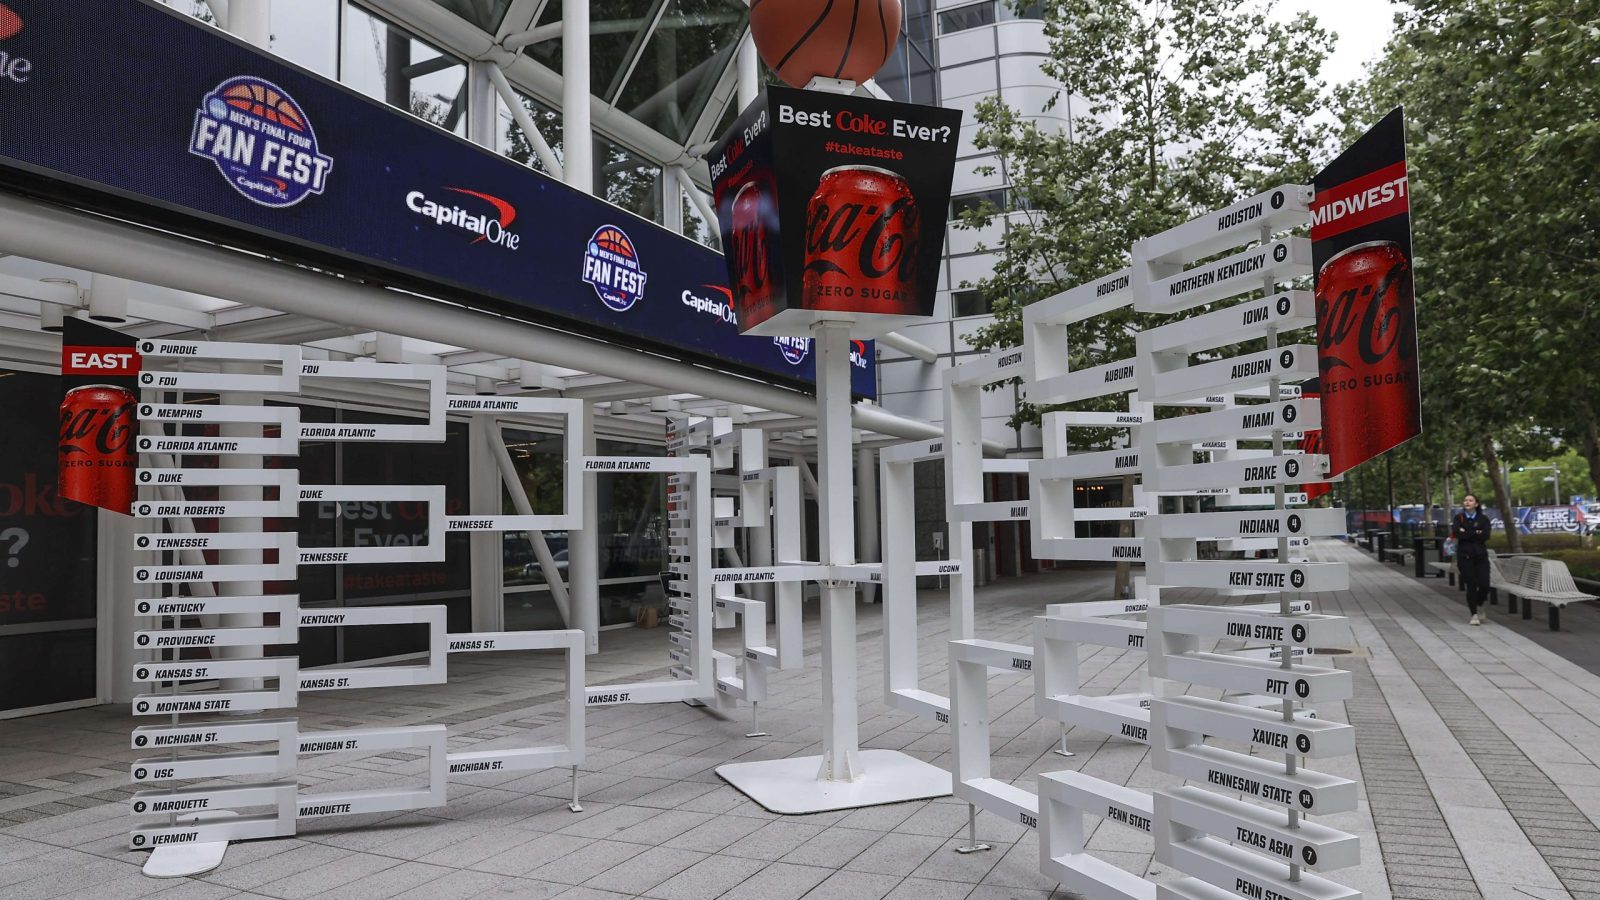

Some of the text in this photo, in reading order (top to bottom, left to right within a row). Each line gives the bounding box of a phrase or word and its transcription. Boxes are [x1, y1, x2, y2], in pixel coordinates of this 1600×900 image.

[229, 110, 312, 150] MEN'S FINAL FOUR
[779, 104, 951, 143] Best Coke Ever?
[711, 154, 728, 182] Best
[743, 109, 766, 146] Ever?
[825, 141, 903, 160] #takeataste
[196, 117, 329, 189] FAN FEST
[1309, 176, 1409, 228] MIDWEST
[1218, 202, 1263, 231] HOUSTON
[585, 256, 645, 296] FAN FEST
[1169, 270, 1215, 296] NORTHERN
[1216, 253, 1266, 281] KENTUCKY
[817, 286, 854, 297] ZERO
[1097, 275, 1129, 297] HOUSTON
[1243, 306, 1269, 325] IOWA
[159, 344, 198, 355] PURDUE
[71, 353, 132, 369] EAST
[997, 352, 1022, 368] HOUSTON
[302, 365, 319, 374] FDU
[1104, 365, 1134, 383] AUBURN
[1231, 358, 1272, 379] AUBURN
[159, 377, 177, 386] FDU
[1324, 378, 1356, 395] ZERO
[449, 400, 518, 410] FLORIDA ATLANTIC
[157, 409, 203, 419] MEMPHIS
[1116, 416, 1143, 424] ARKANSAS
[1242, 411, 1274, 429] MIAMI
[301, 428, 376, 438] FLORIDA ATLANTIC
[157, 441, 195, 450] FLORIDA
[196, 441, 238, 451] ATLANTIC
[586, 461, 650, 470] FLORIDA ATLANTIC
[1115, 454, 1139, 468] MIAMI
[157, 473, 183, 483] DUKE
[1244, 465, 1277, 482] DRAKE
[300, 490, 323, 499] DUKE
[157, 506, 181, 515] ORAL
[183, 506, 226, 515] ROBERTS
[1010, 506, 1028, 518] MIAMI
[449, 520, 493, 529] TENNESSEE
[1239, 519, 1280, 533] INDIANA
[156, 538, 209, 548] TENNESSEE
[300, 553, 348, 562] TENNESSEE
[1112, 545, 1142, 558] INDIANA
[939, 564, 960, 573] UCONN
[155, 571, 204, 581] LOUISIANA
[714, 572, 775, 582] FLORIDA ATLANTIC
[1229, 571, 1253, 586] KENT
[1255, 572, 1286, 588] STATE
[157, 603, 206, 613] KENTUCKY
[300, 615, 345, 624] KENTUCKY
[1227, 622, 1251, 638] IOWA
[1254, 624, 1284, 641] STATE
[156, 635, 215, 646] PROVIDENCE
[449, 640, 495, 650] KANSAS ST.
[1128, 634, 1144, 648] PITT
[1012, 657, 1032, 671] XAVIER
[155, 668, 192, 679] KANSAS
[195, 668, 209, 677] ST.
[300, 678, 350, 689] KANSAS ST.
[1266, 678, 1289, 695] PITT
[587, 693, 631, 704] KANSAS ST.
[156, 702, 201, 712] MONTANA
[203, 700, 231, 710] STATE
[935, 711, 949, 724] TEXAS
[1121, 722, 1148, 741] XAVIER
[154, 734, 202, 745] MICHIGAN
[204, 733, 218, 742] ST.
[1252, 728, 1288, 749] XAVIER
[300, 740, 358, 752] MICHIGAN ST.
[154, 768, 174, 779] USC
[449, 761, 504, 773] MICHIGAN ST.
[1208, 769, 1260, 795] KENNESAW
[1262, 784, 1292, 805] STATE
[152, 799, 209, 811] MARQUETTE
[299, 804, 351, 816] MARQUETTE
[1020, 812, 1037, 828] TEXAS
[1108, 806, 1151, 832] PENN STATE
[152, 832, 199, 845] VERMONT
[1236, 826, 1267, 849] TEXAS
[1268, 841, 1293, 859] A&M
[1236, 878, 1262, 900] PENN
